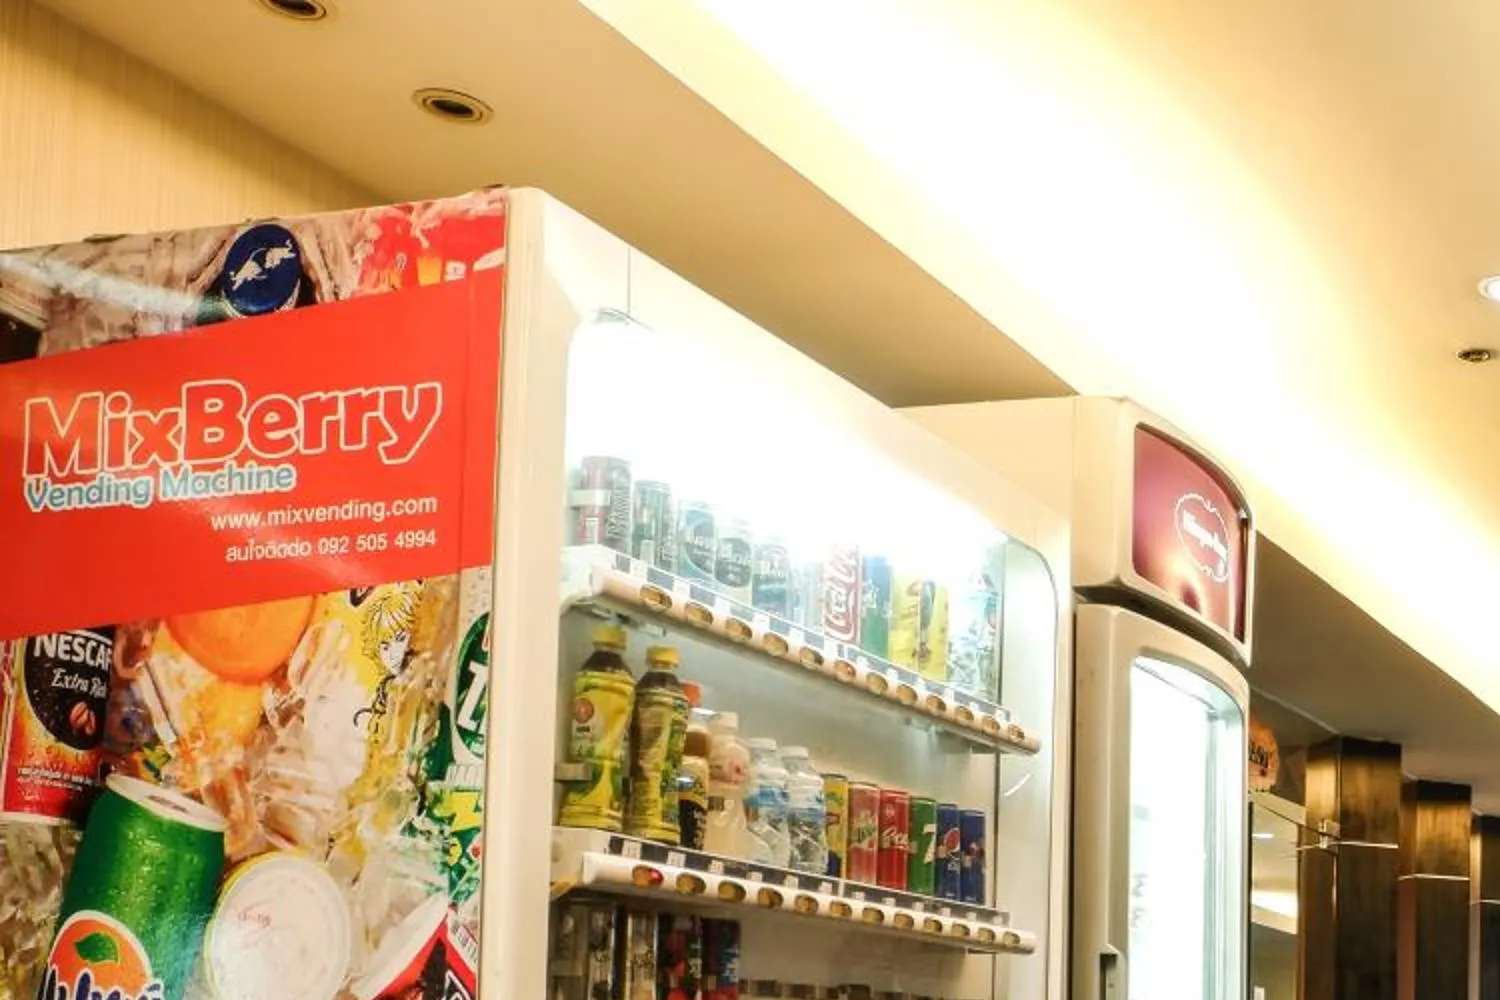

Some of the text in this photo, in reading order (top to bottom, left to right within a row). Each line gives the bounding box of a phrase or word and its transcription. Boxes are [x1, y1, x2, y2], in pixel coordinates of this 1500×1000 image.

[23, 379, 442, 478] MixBerry
[24, 459, 297, 513] Vending Machine
[210, 496, 438, 532] www.mixvending.com
[318, 536, 350, 555] 092
[356, 532, 388, 552] 505
[394, 528, 437, 549] 4994
[51, 667, 89, 691] Extra
